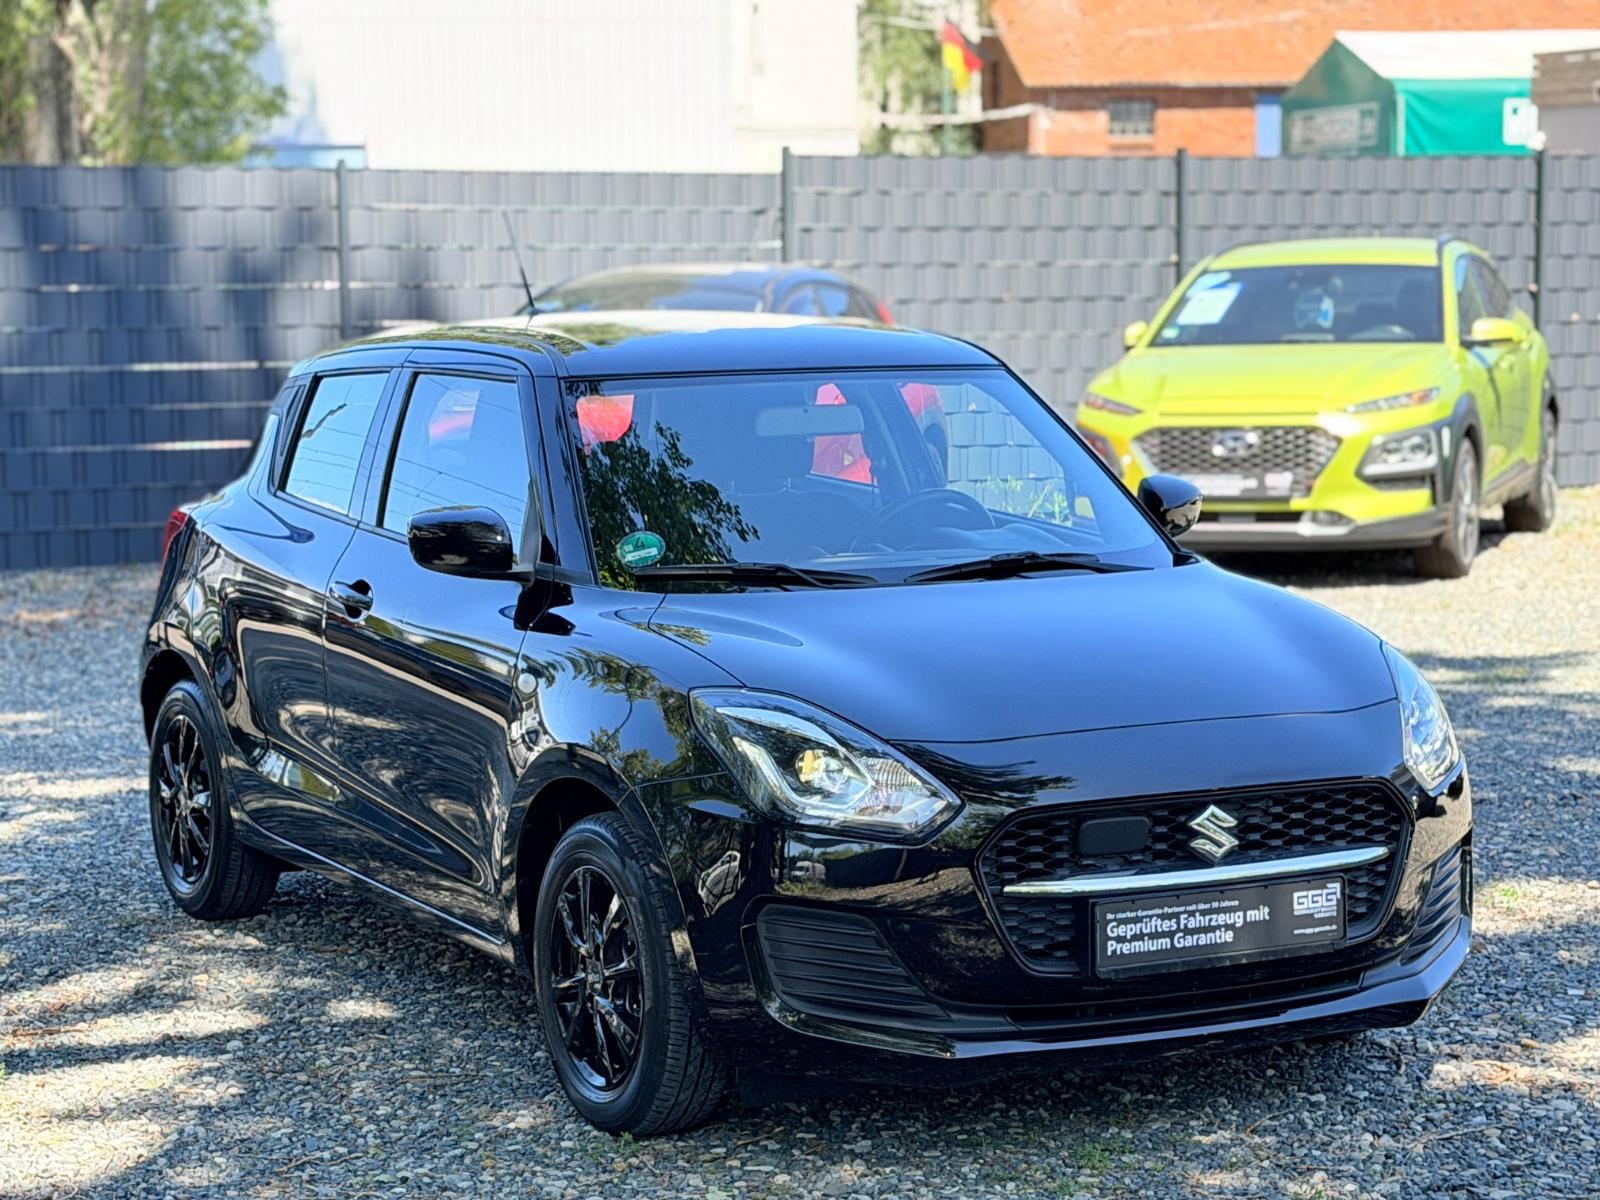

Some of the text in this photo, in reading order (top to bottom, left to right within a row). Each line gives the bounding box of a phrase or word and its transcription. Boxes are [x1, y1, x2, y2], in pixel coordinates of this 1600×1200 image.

[1116, 910, 1136, 919] starker
[1137, 906, 1185, 916] Garantie-Partner
[1197, 902, 1211, 910] über
[1219, 899, 1239, 908] Jahren
[1293, 889, 1337, 910] GGG
[1106, 904, 1270, 940] Geprüftes Fahrzeug mit
[1107, 927, 1234, 956] Premium Garantie
